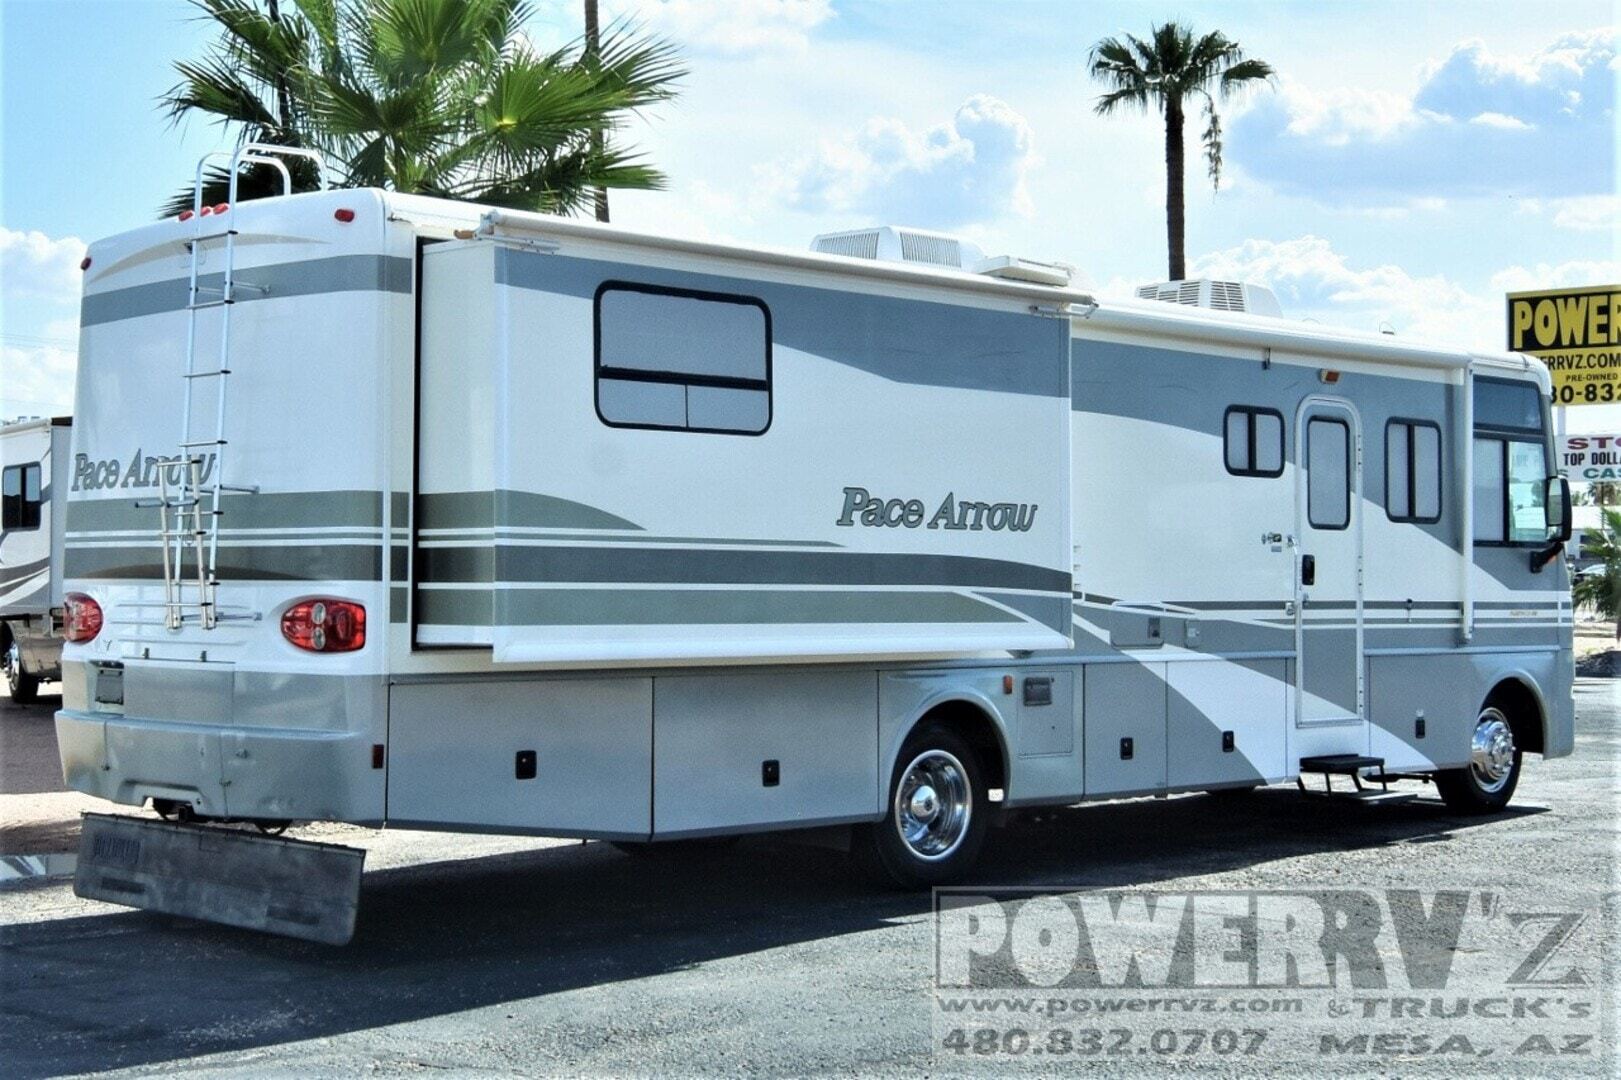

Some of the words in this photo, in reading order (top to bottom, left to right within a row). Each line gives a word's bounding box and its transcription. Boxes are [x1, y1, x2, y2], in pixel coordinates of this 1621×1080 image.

[1565, 372, 1619, 382] PRE-OWNED
[1562, 452, 1586, 466] TOP
[1591, 451, 1621, 466] DOLL
[71, 453, 121, 492] Pace
[121, 448, 217, 489] Arrow
[1583, 467, 1621, 479] CA
[836, 487, 925, 529] Pace
[927, 491, 1038, 532] Arrow
